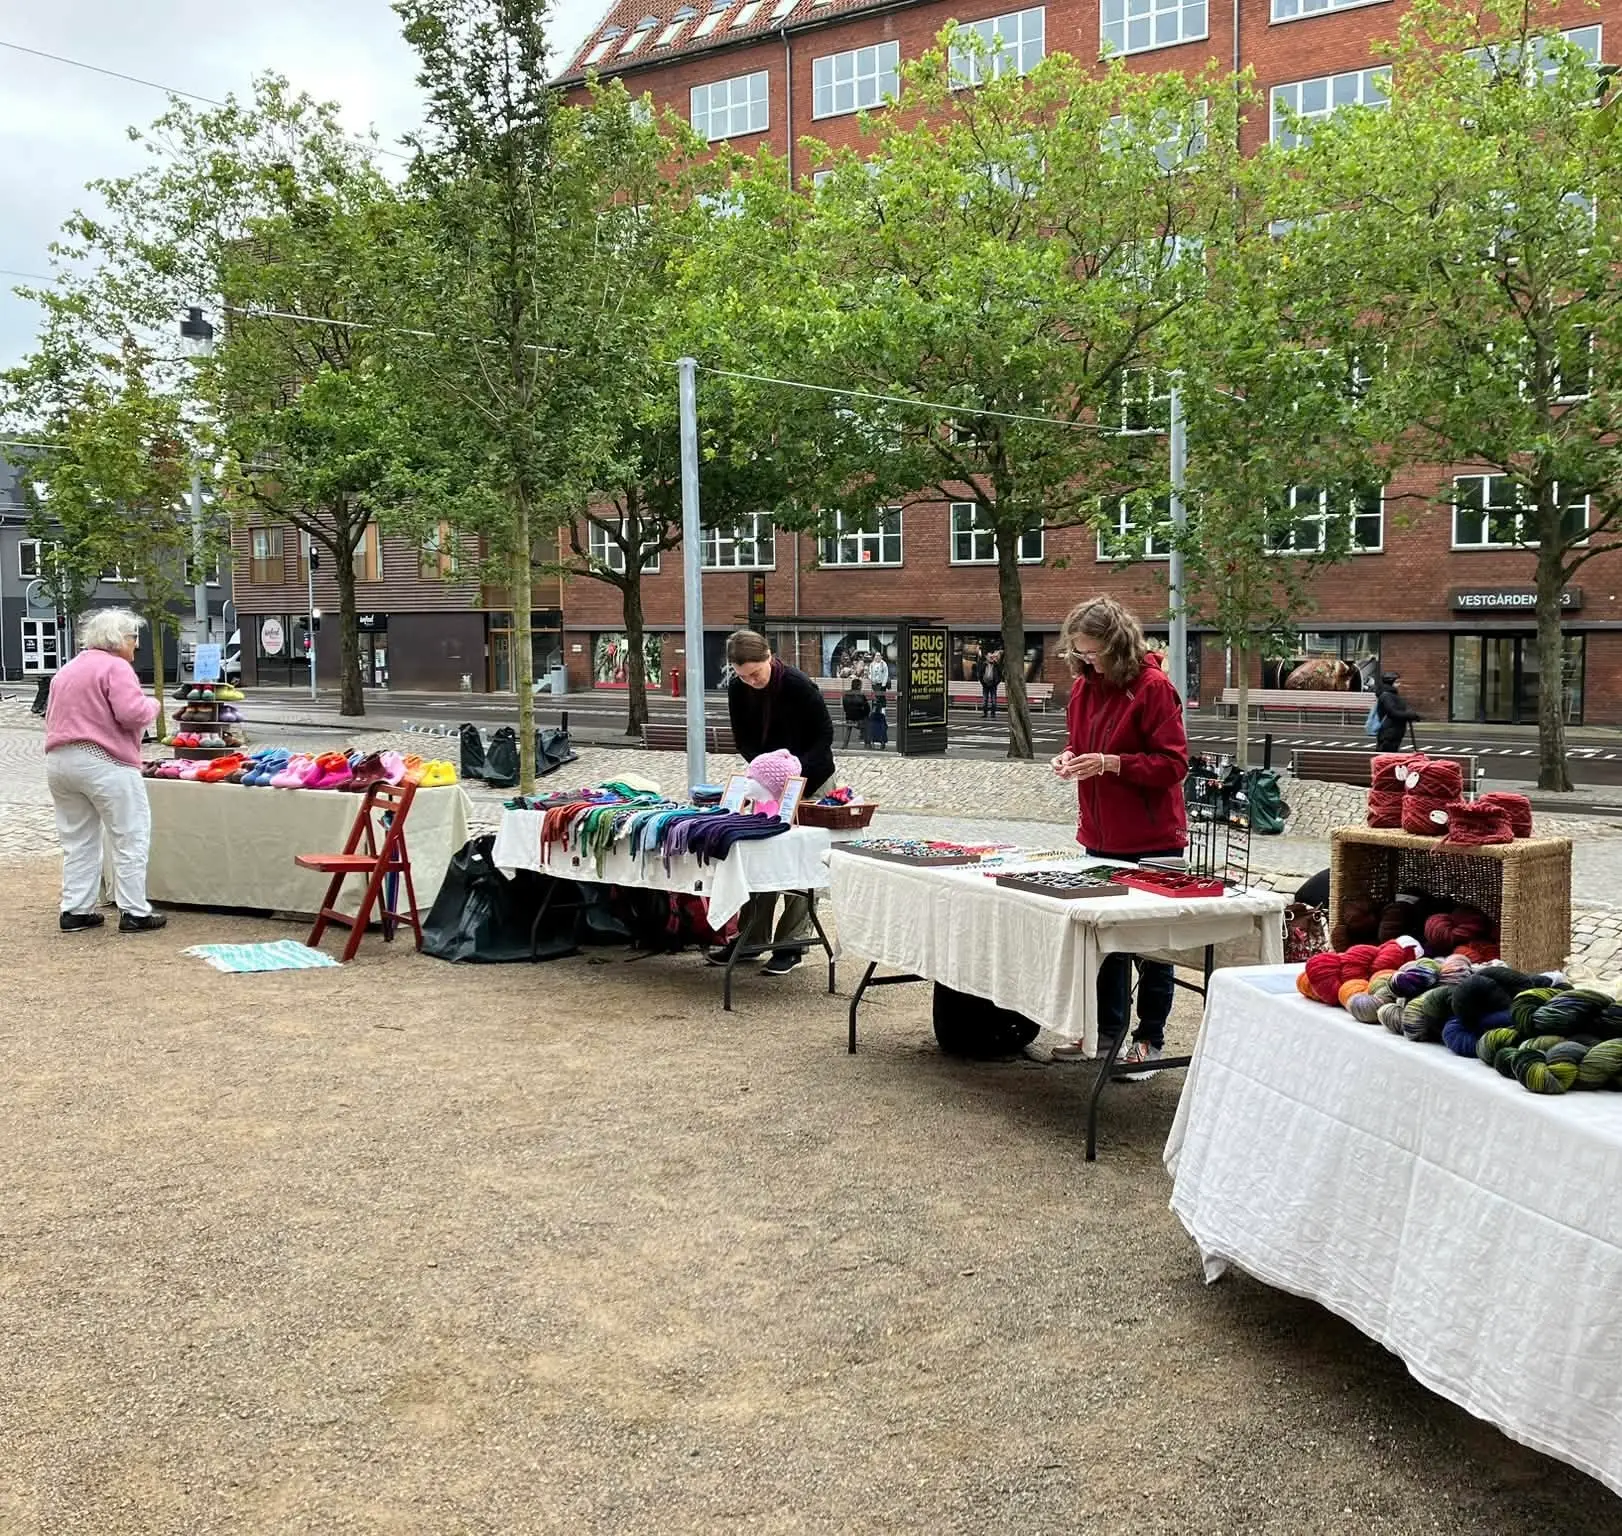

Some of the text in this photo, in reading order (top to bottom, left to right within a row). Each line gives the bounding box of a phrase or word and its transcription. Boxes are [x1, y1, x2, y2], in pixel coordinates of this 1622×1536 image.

[1458, 594, 1538, 605] VESTGÅRDEN
[912, 635, 943, 650] BRUG
[912, 652, 942, 668] 2 SEK
[912, 669, 943, 685] MERE
